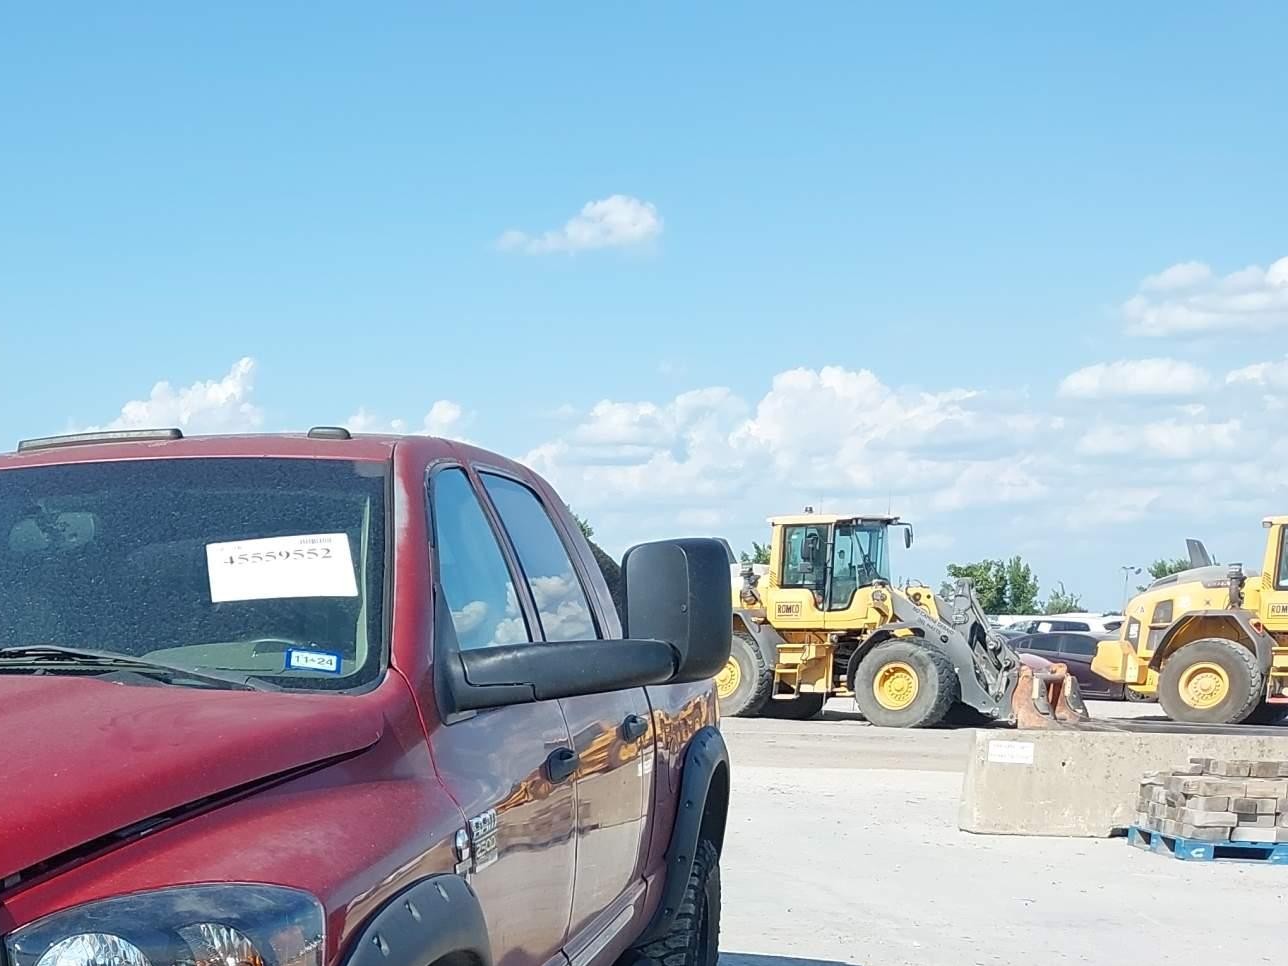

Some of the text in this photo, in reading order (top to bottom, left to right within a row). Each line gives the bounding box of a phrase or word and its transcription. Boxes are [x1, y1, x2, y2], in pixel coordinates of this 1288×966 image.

[223, 547, 332, 566] 45559552
[777, 604, 800, 614] ROMCO
[475, 835, 497, 858] 2500
